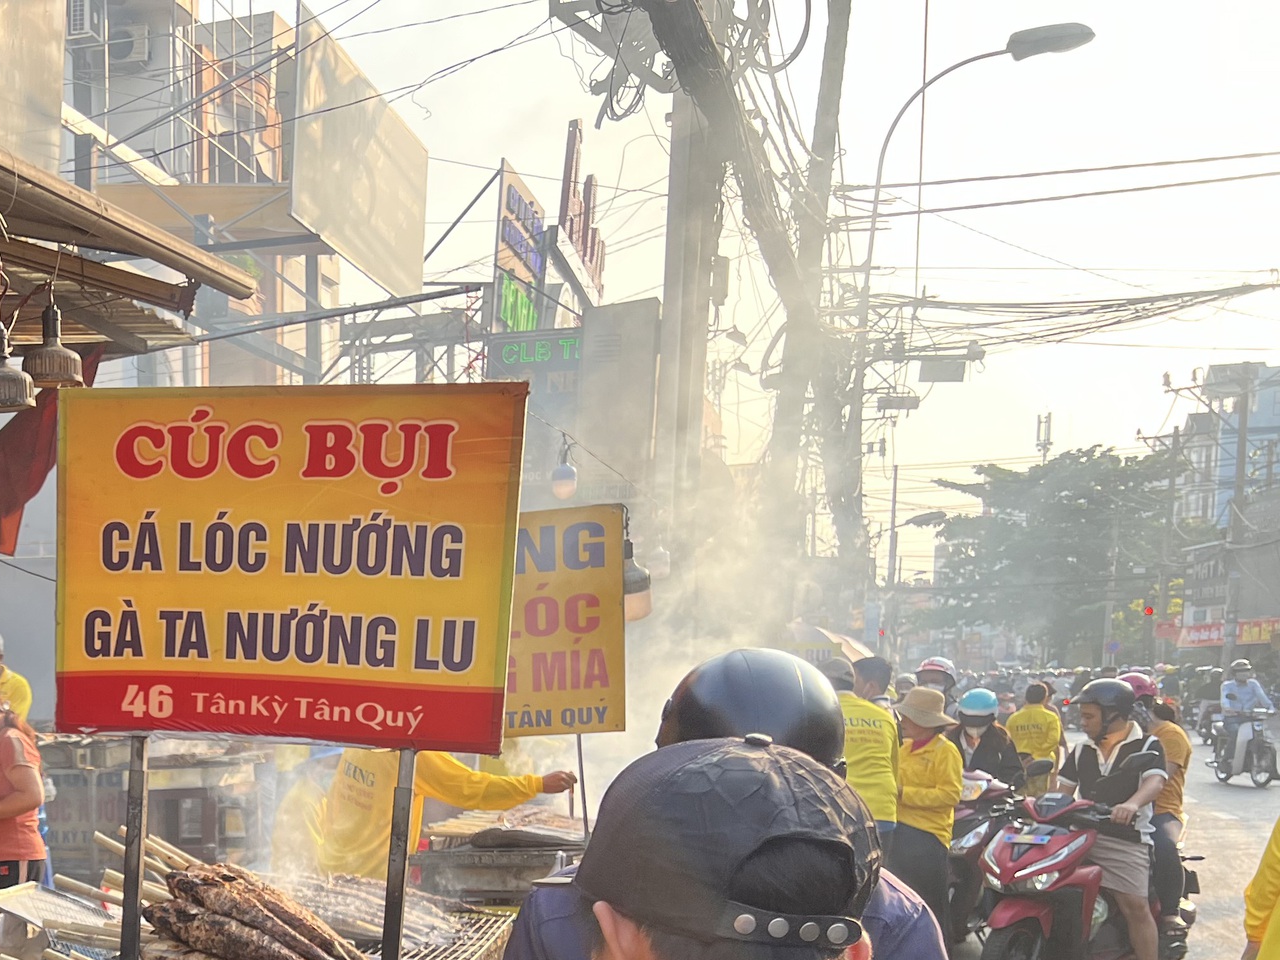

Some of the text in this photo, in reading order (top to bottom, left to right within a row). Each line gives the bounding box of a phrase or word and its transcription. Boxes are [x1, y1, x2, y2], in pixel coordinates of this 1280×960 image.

[114, 406, 460, 496] CÚC BỤI
[100, 510, 465, 579] CÁ LÓC NƯỚNG
[84, 599, 476, 673] GÀ TA NƯỚNG LU
[532, 636, 610, 692] MÍA
[122, 684, 173, 719] 46
[354, 699, 424, 735] Quý
[561, 698, 608, 727] QUÝ
